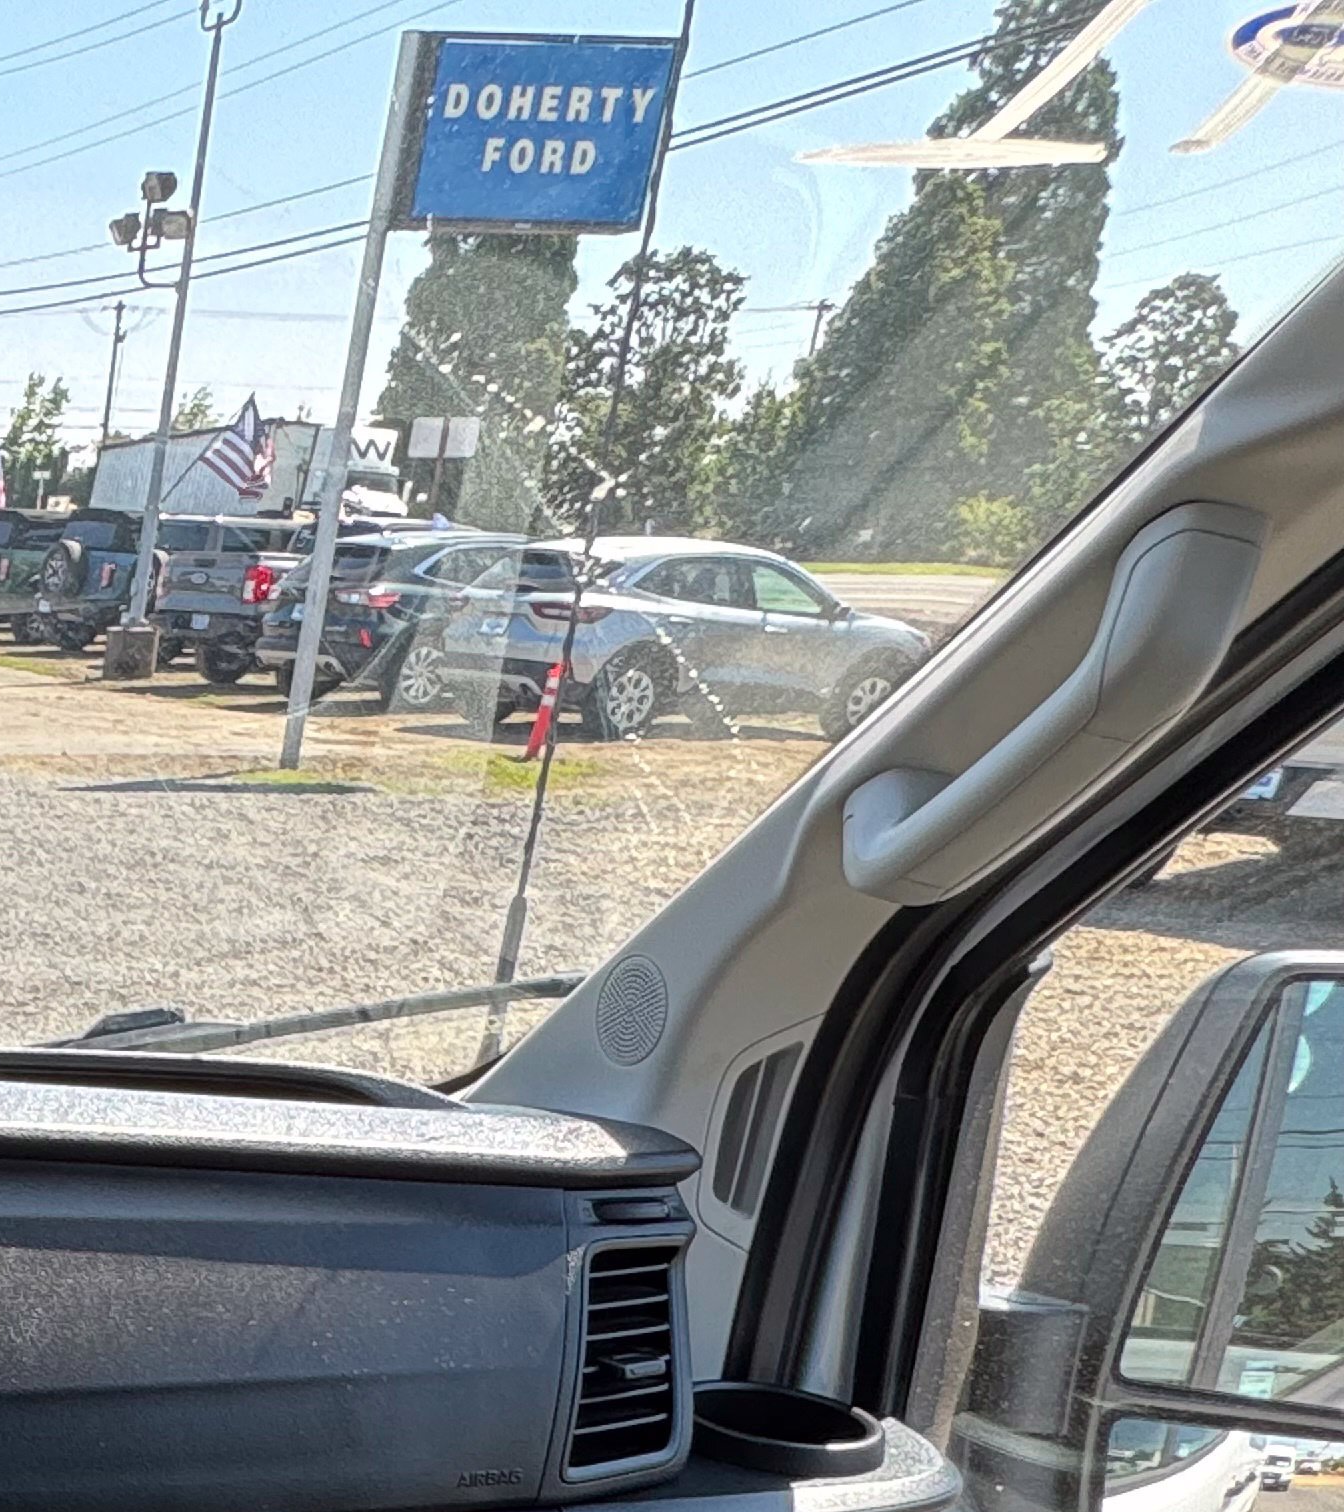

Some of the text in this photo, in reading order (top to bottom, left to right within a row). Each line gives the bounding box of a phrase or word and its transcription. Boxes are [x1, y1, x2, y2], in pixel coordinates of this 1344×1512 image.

[443, 83, 657, 123] DOHERTY
[481, 137, 597, 174] FORD
[456, 1467, 524, 1488] AIRBAG
